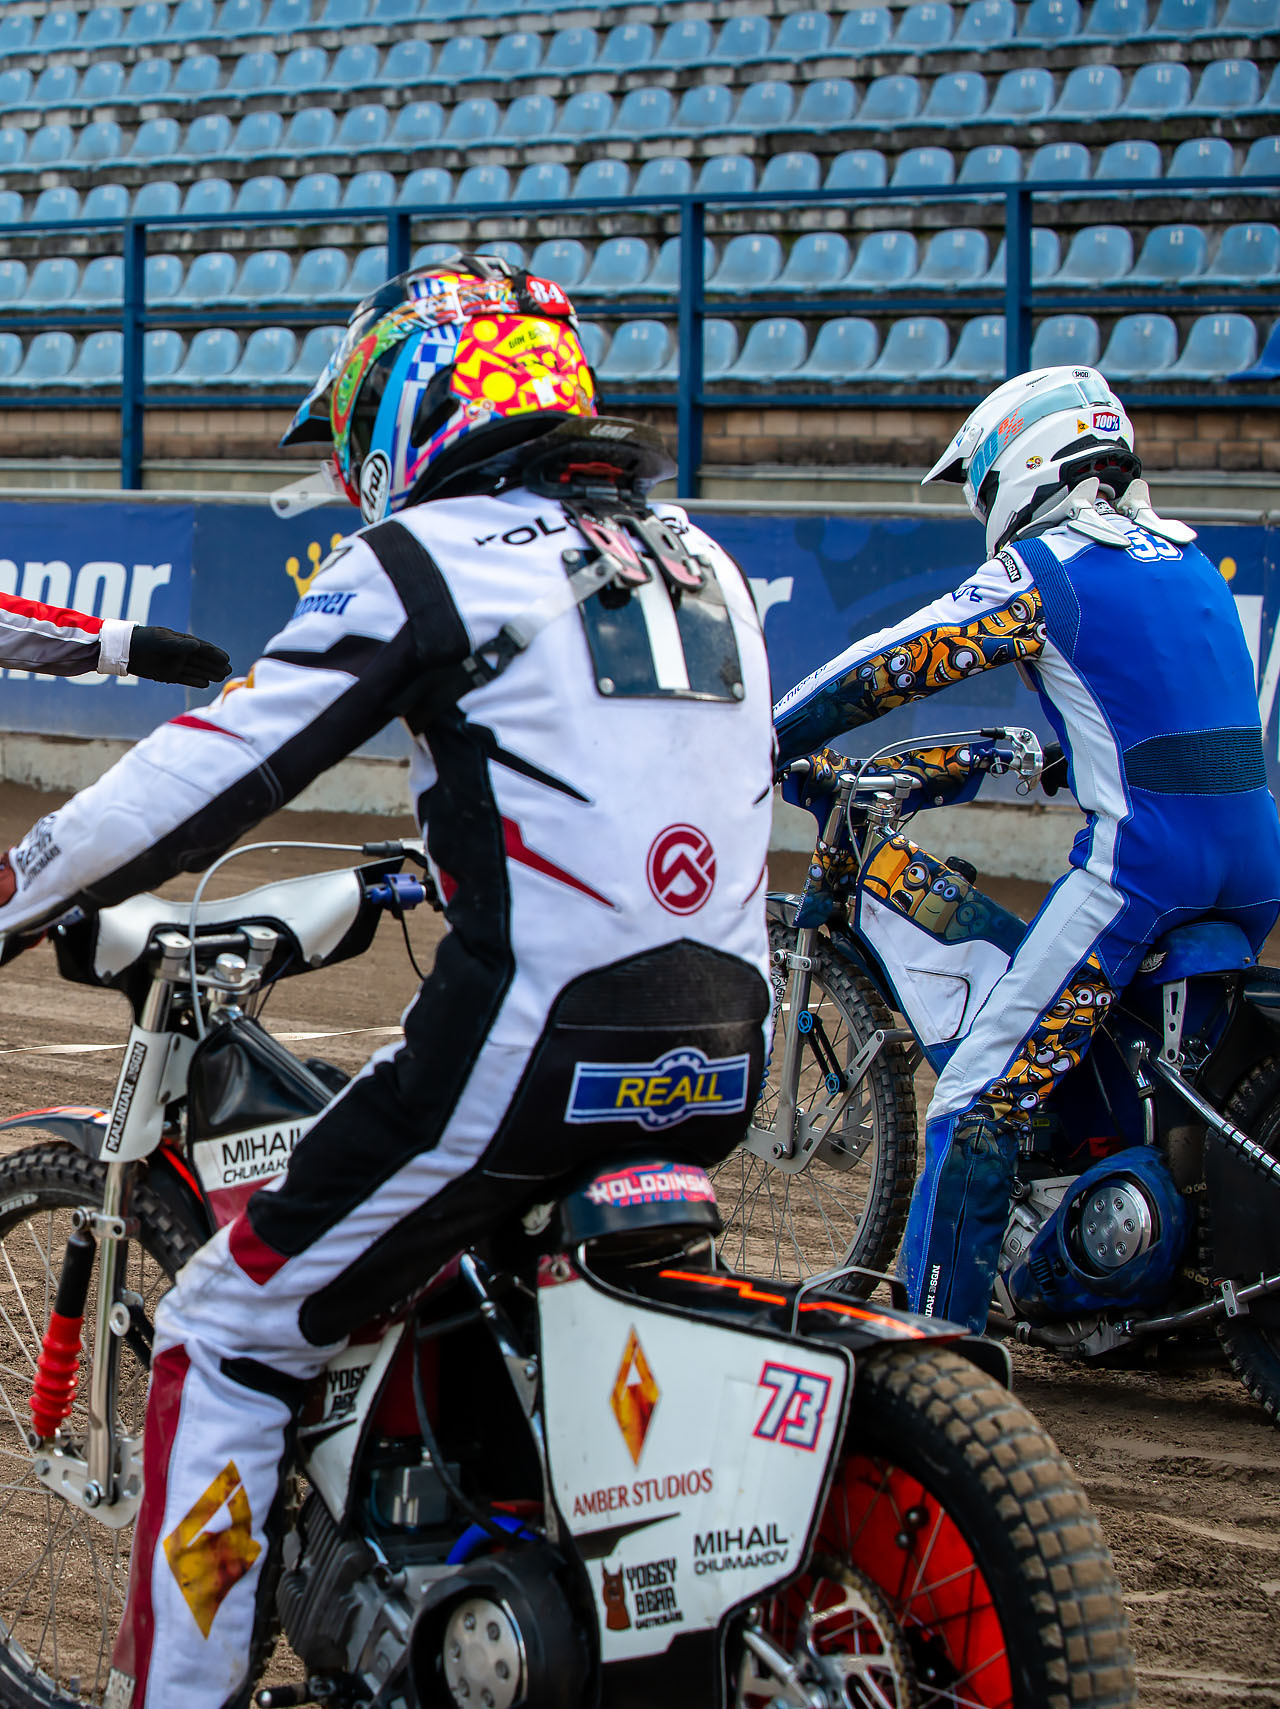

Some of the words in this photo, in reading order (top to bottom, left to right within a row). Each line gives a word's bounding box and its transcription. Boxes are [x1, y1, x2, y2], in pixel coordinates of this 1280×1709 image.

[1095, 414, 1119, 430] 100%
[616, 1072, 724, 1108] REALL
[108, 1081, 135, 1151] MALINIAK
[223, 1157, 289, 1184] CHUMAK
[751, 1359, 834, 1454] 73
[572, 1484, 630, 1518] AMBER
[632, 1467, 714, 1507] STUDIOS
[693, 1522, 789, 1558] MIHAIL
[626, 1556, 677, 1592] YOGGY
